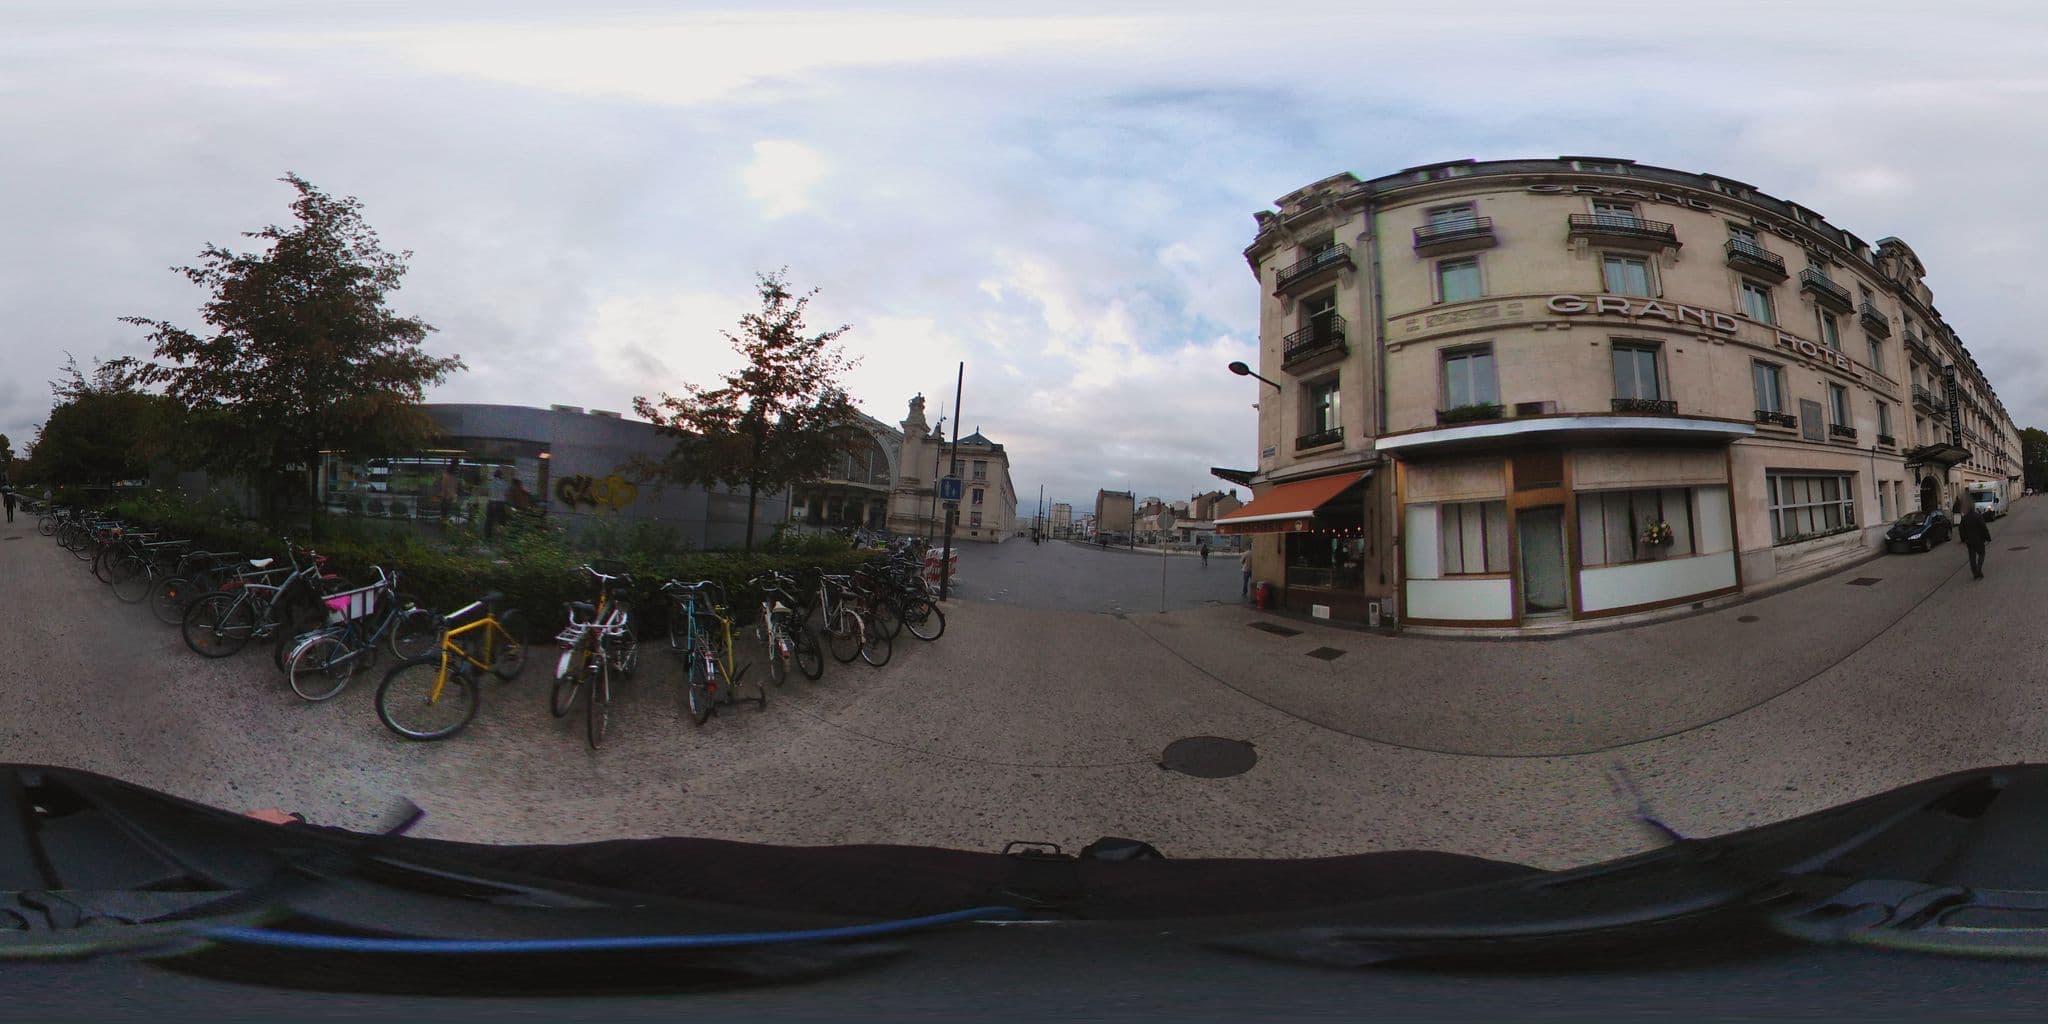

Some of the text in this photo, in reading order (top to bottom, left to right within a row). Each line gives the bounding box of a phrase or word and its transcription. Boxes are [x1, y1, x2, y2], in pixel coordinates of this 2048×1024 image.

[1527, 184, 1846, 268] GRAND HOTEL
[1547, 295, 1863, 378] GRAND HOTEL
